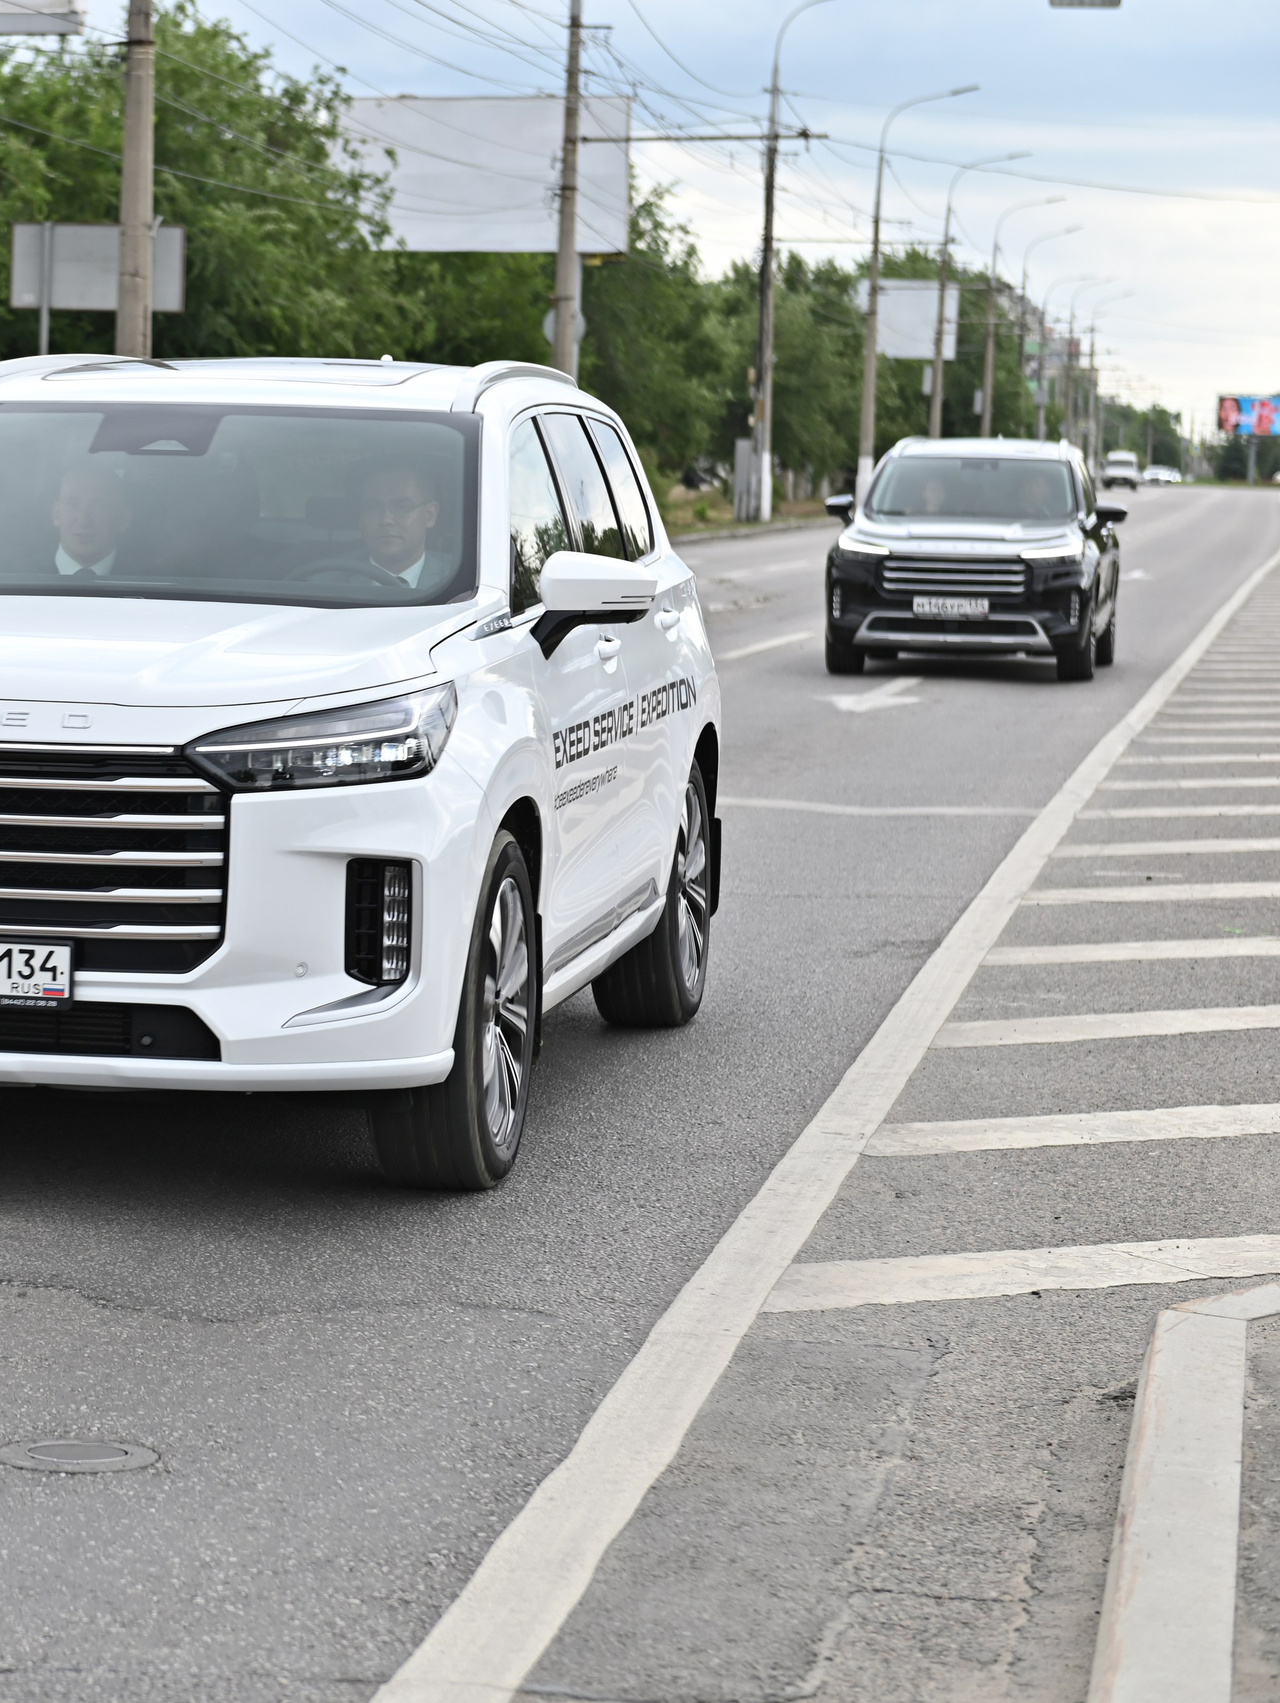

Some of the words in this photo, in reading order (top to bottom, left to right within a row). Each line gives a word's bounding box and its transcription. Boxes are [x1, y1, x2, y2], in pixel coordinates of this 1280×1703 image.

[552, 720, 591, 770] EXEED
[593, 701, 634, 752] SERVICE
[640, 675, 698, 729] EXPEDITION
[10, 982, 41, 996] RUS
